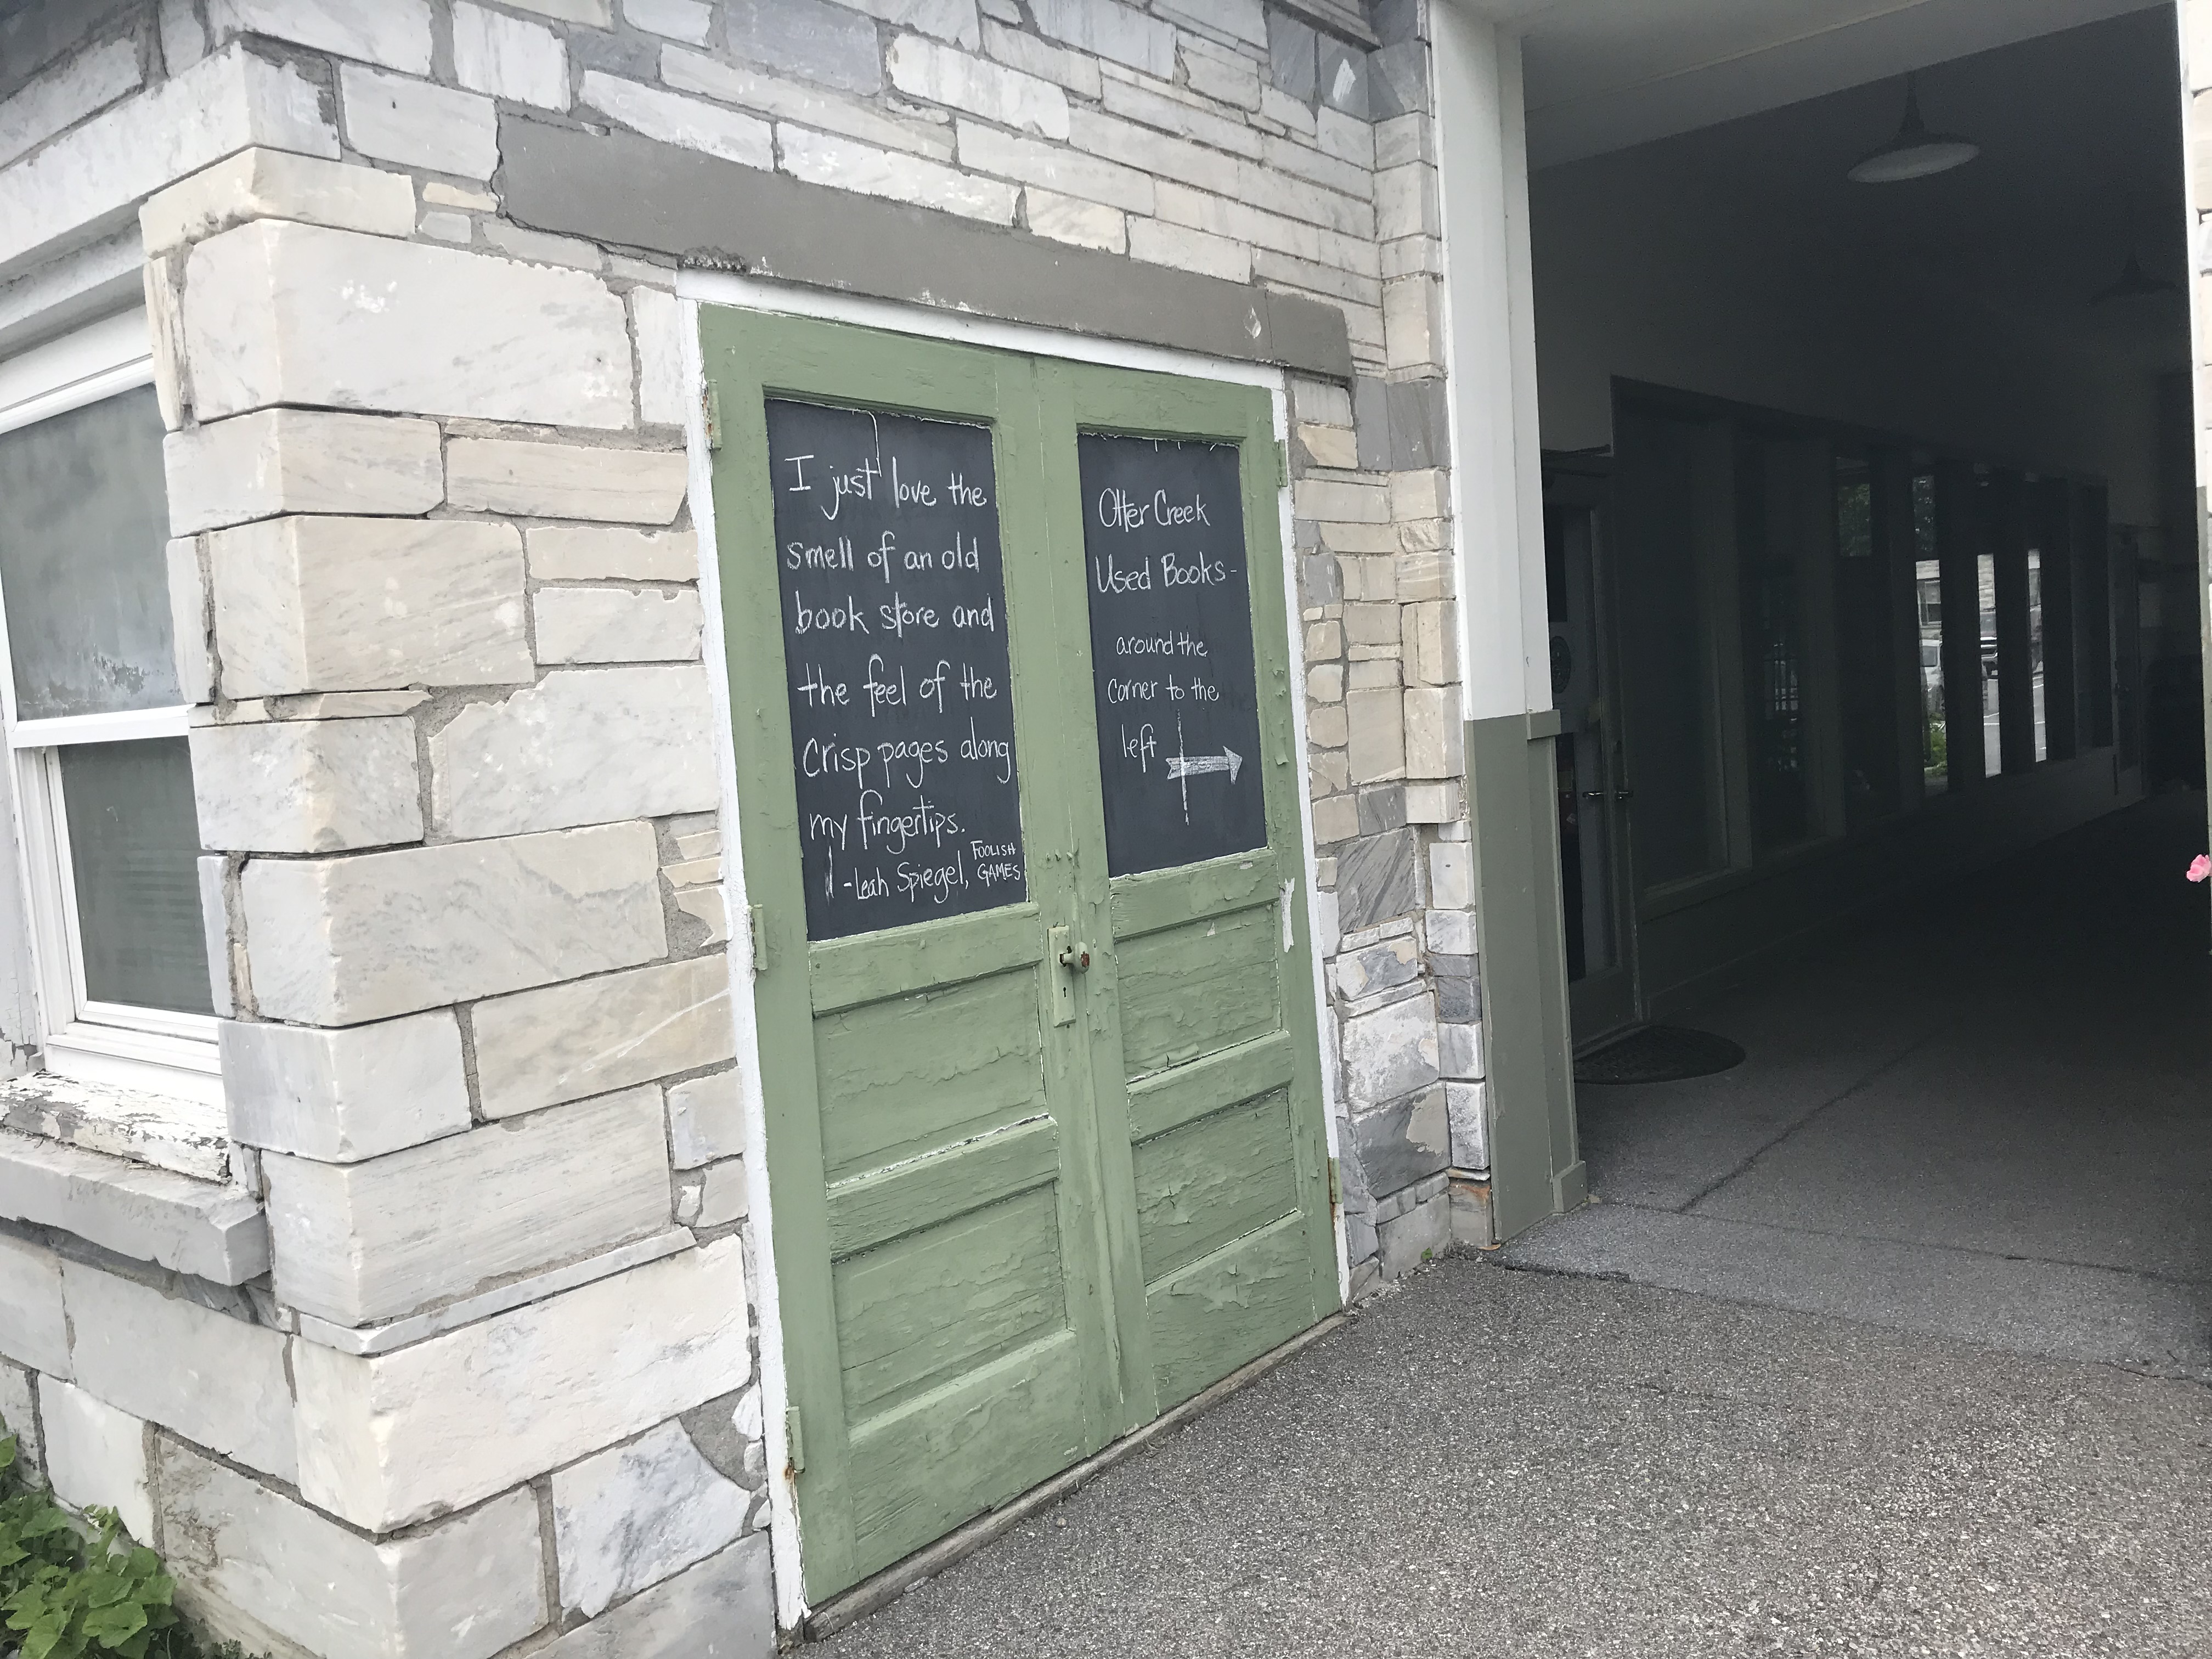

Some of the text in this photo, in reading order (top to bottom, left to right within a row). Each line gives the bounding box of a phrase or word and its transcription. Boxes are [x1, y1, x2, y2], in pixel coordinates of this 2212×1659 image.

[785, 454, 986, 520] I just love the
[1099, 488, 1210, 532] Otter Creek
[867, 531, 896, 583] of
[904, 550, 933, 571] an
[941, 532, 979, 573] old
[1096, 554, 1151, 593] Used
[794, 590, 994, 637] book store and
[1116, 631, 1207, 657] around the
[797, 653, 997, 717] the feel of the
[1165, 674, 1184, 701] to
[1190, 677, 1219, 701] the
[878, 740, 949, 788] pages
[961, 716, 1011, 783] along
[1121, 724, 1156, 773] left
[810, 789, 966, 854] my fingertips.
[897, 850, 969, 904] Spiegel,
[977, 862, 1020, 887] GAMES
